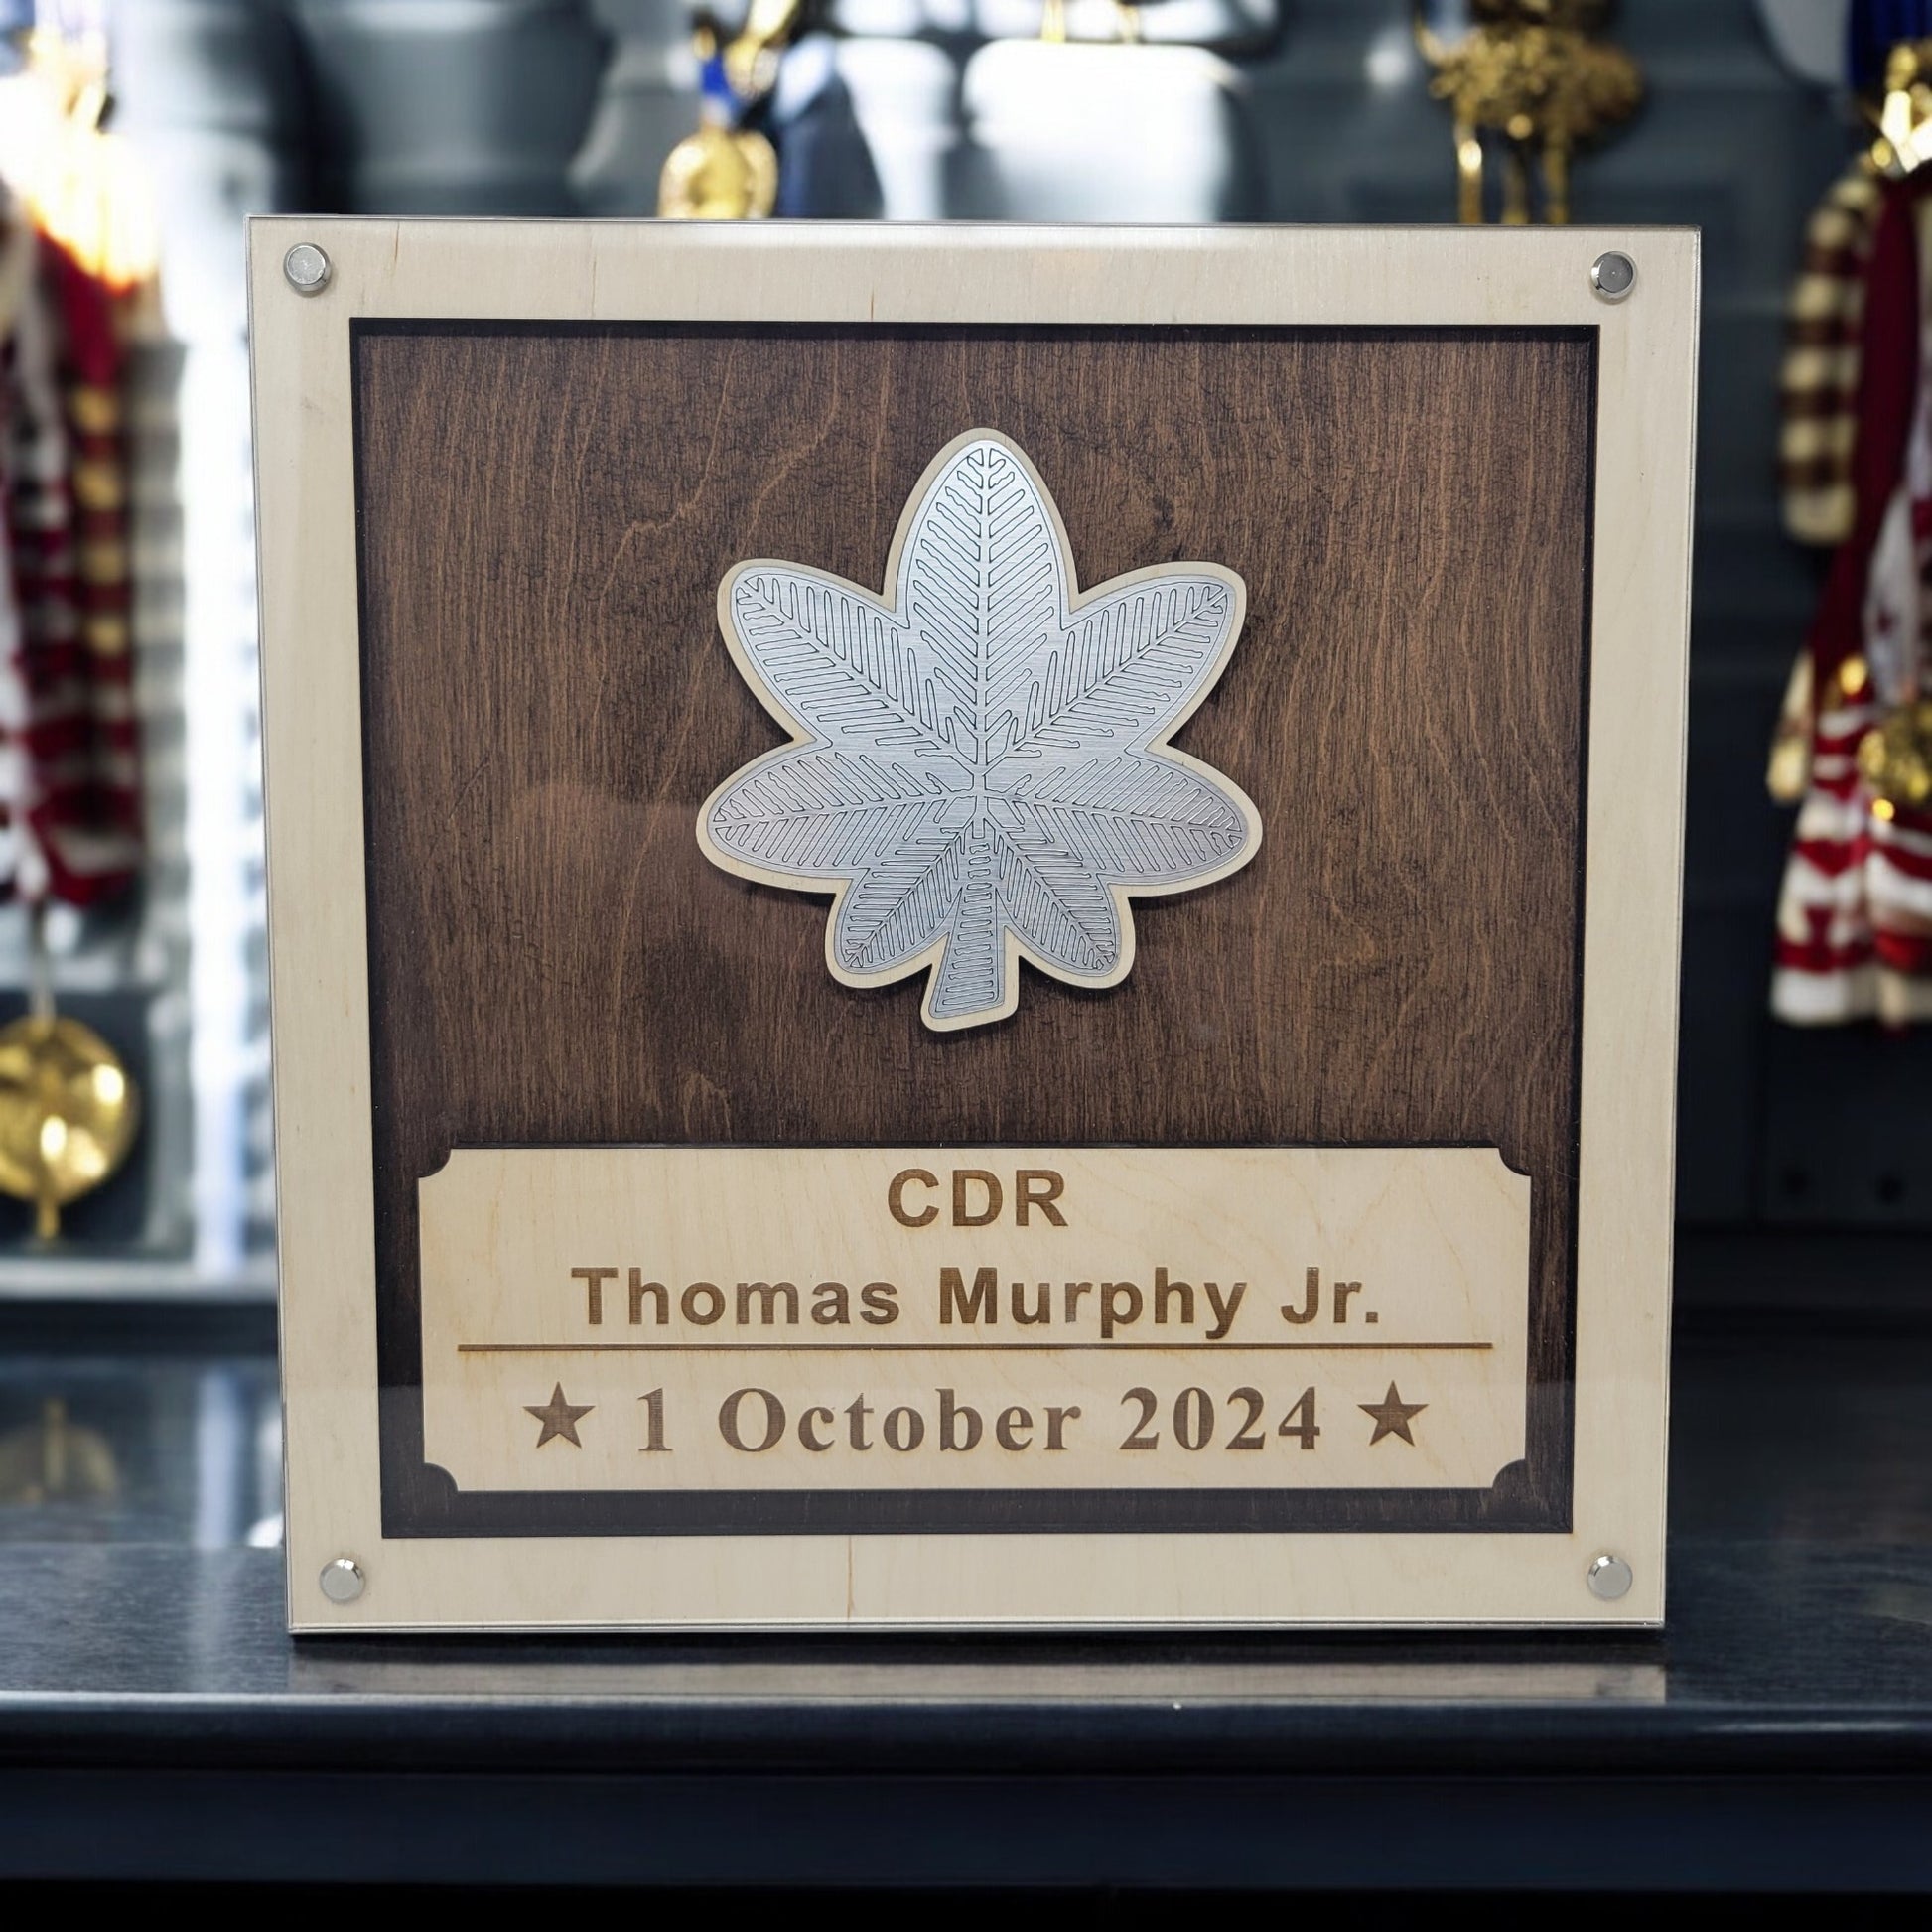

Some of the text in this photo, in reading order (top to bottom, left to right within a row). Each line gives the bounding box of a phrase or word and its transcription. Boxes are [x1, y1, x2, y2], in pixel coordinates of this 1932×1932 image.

[888, 1169, 1067, 1227] CDR
[571, 1267, 1378, 1340] Thomas Murphy Jr.
[638, 1387, 1320, 1452] 1 October 2024
